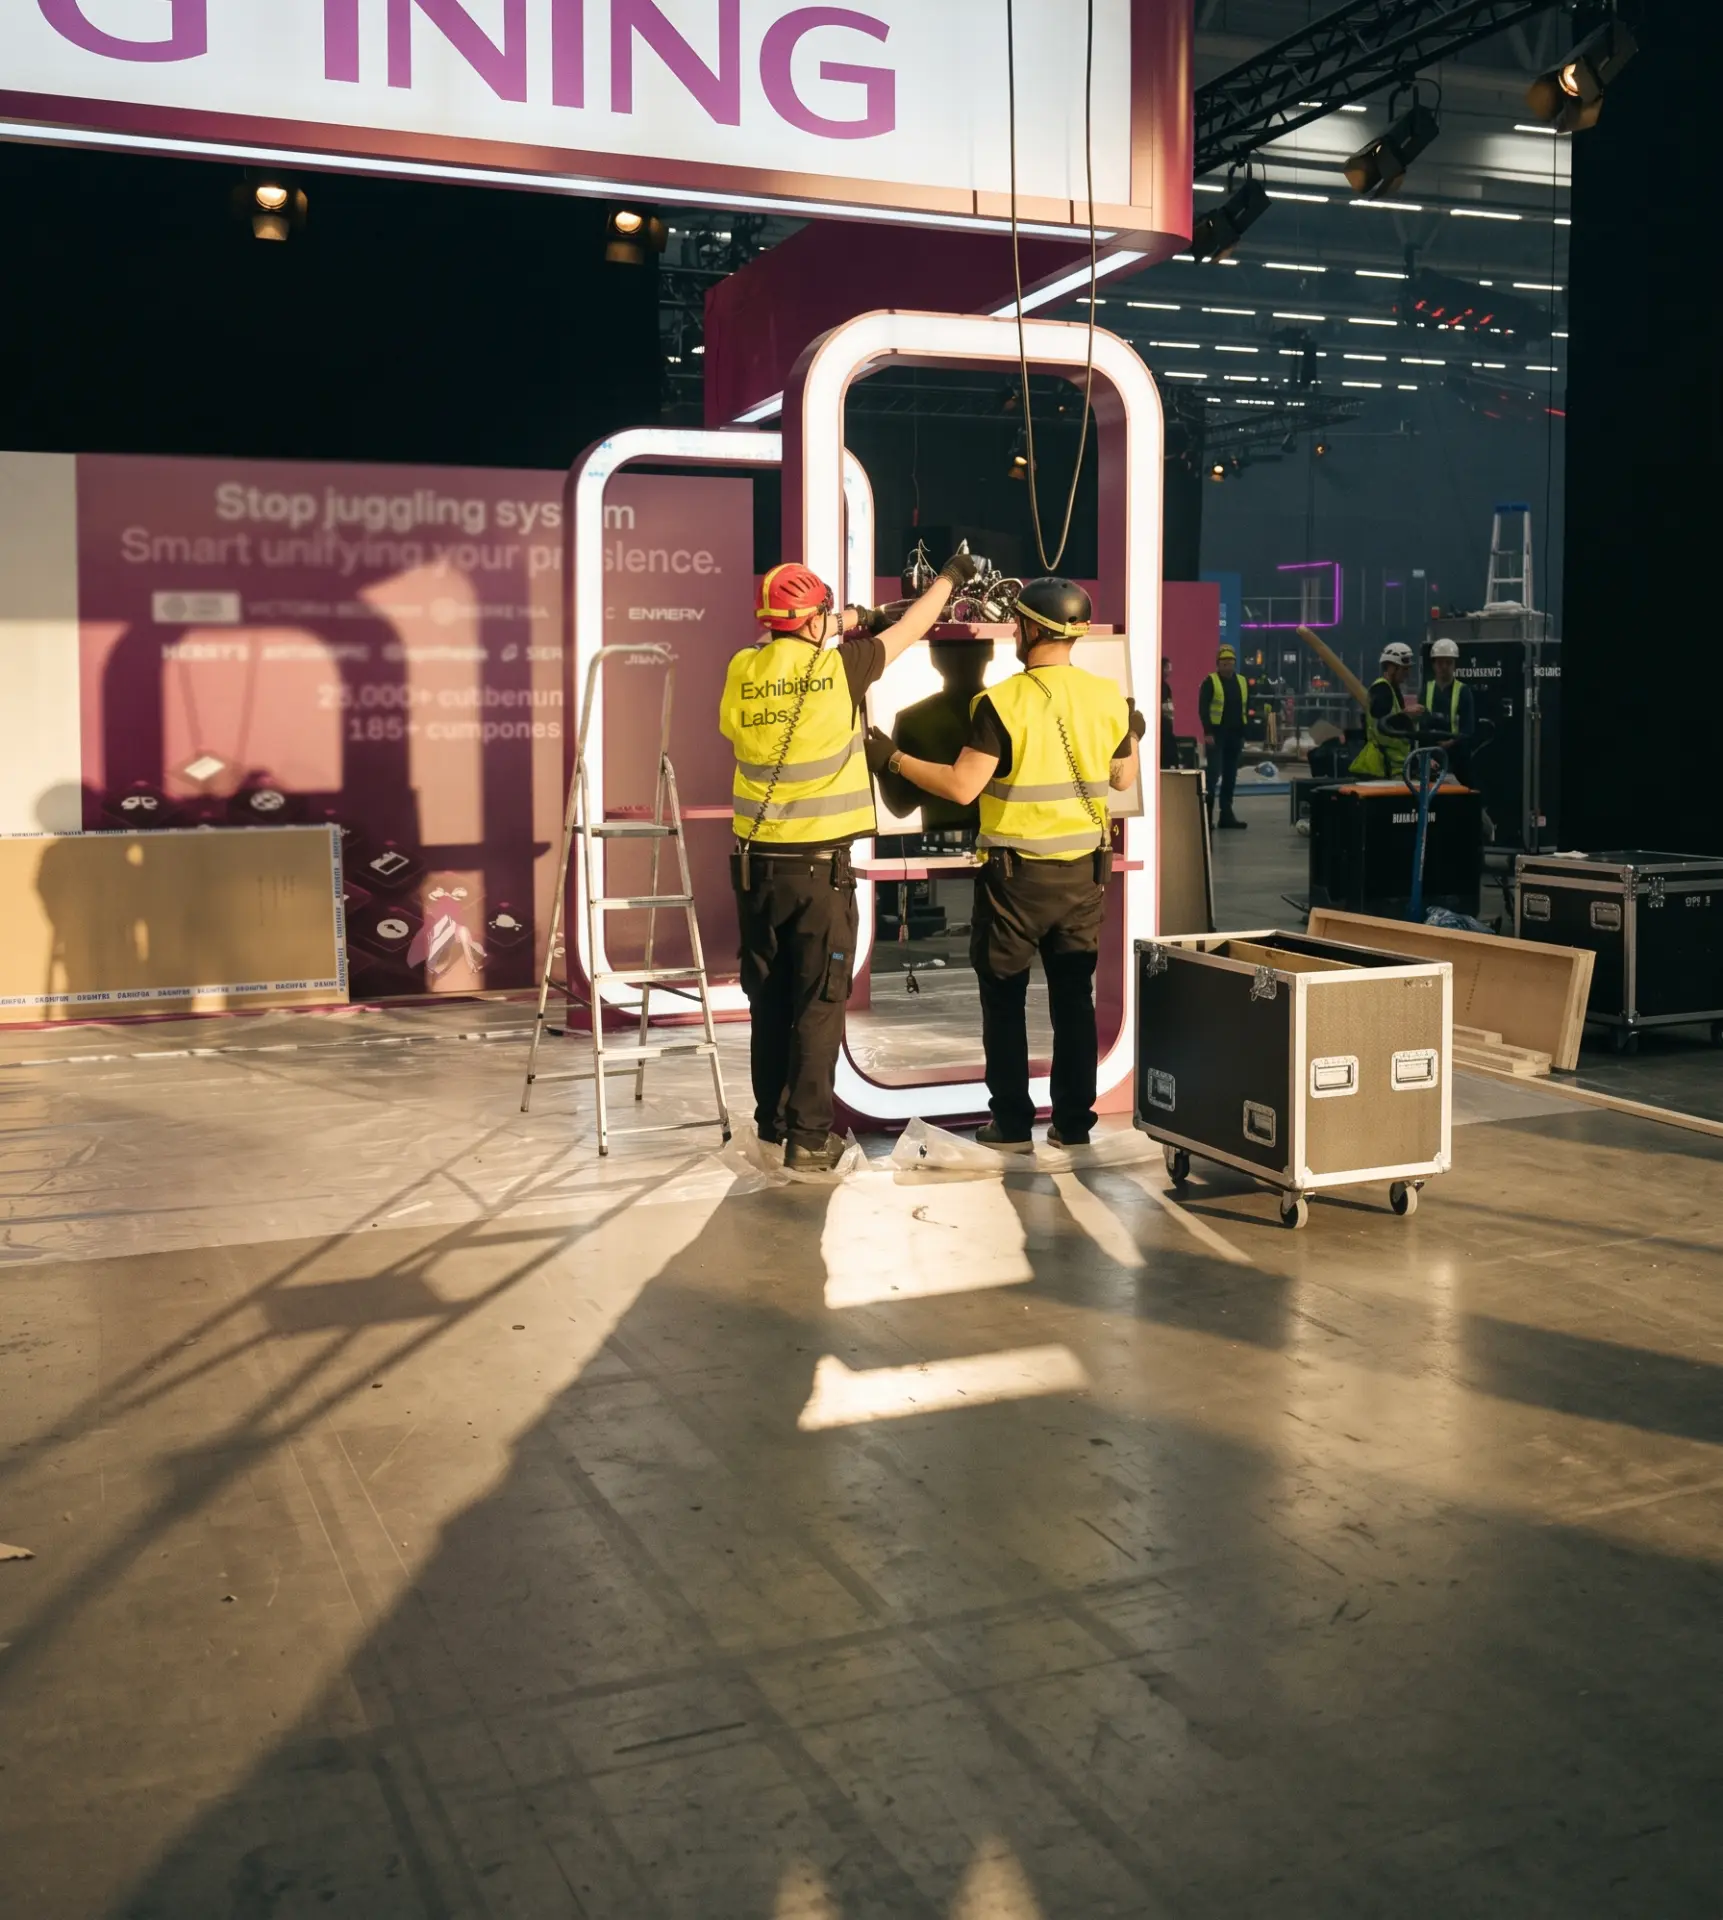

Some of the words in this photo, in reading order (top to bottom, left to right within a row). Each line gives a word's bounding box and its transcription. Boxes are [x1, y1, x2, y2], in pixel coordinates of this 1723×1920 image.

[214, 482, 317, 530] Stop
[323, 484, 486, 536] juggling
[120, 525, 254, 565] Smart
[430, 542, 520, 580] your
[740, 675, 834, 701] Exhibition
